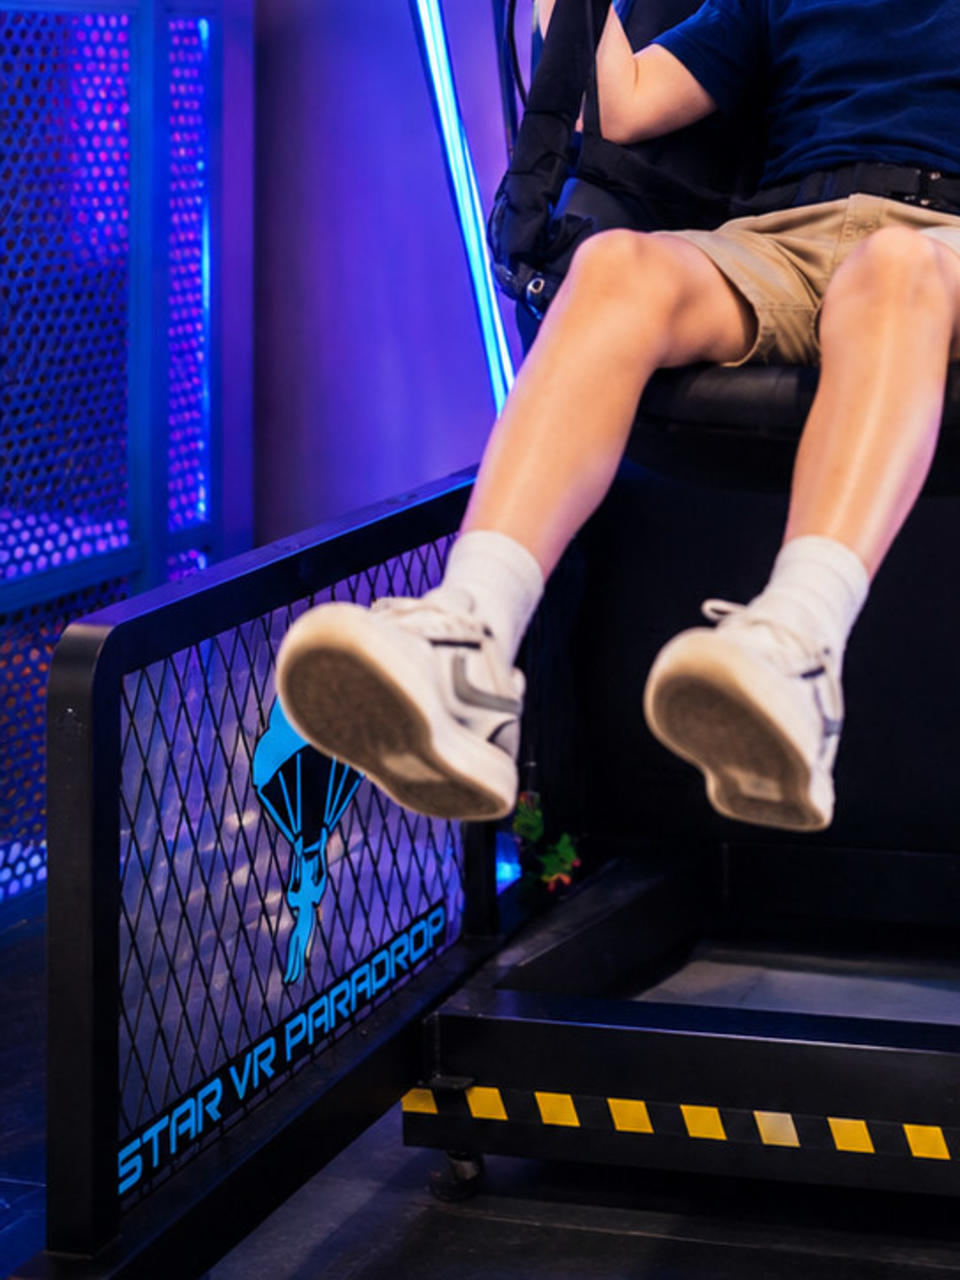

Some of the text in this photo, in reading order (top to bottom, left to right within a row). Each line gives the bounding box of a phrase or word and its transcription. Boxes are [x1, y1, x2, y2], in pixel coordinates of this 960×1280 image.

[118, 906, 446, 1196] STAR VR PARADROP
